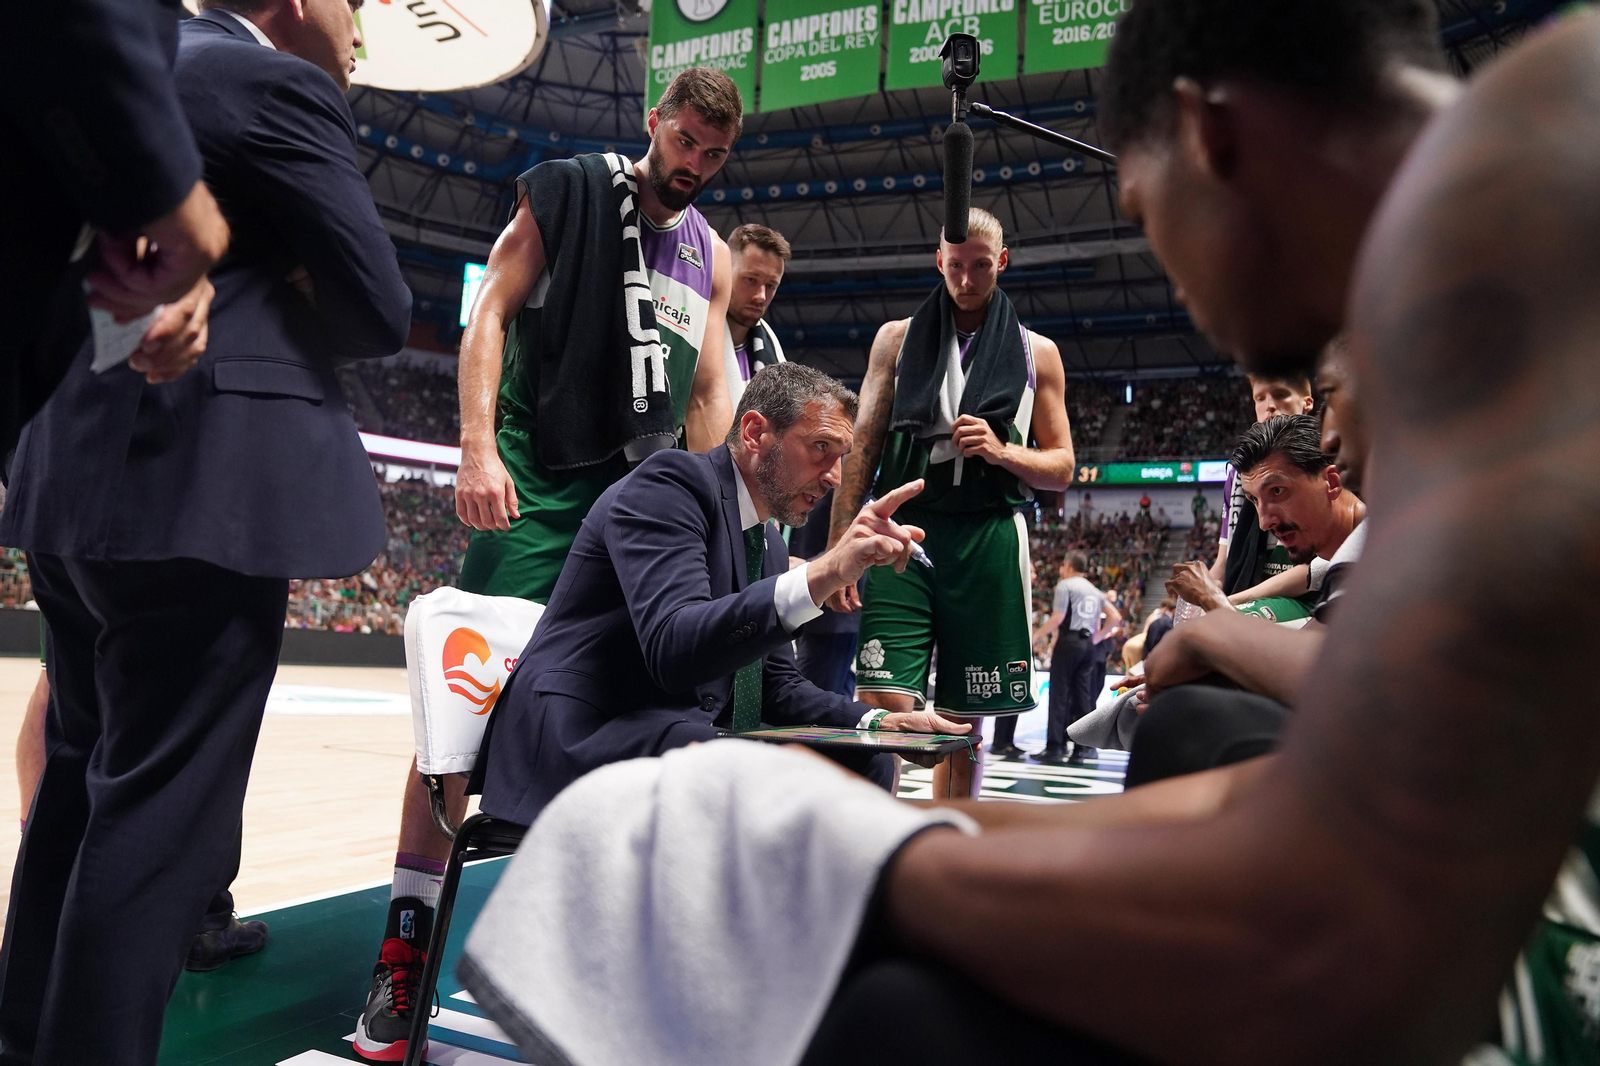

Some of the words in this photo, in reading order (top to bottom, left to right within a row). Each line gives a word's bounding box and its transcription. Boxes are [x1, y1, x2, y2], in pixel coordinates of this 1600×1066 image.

[768, 5, 878, 48] CAMPEONES
[651, 27, 753, 69] CAMPEONES
[764, 43, 806, 64] COPA
[809, 38, 841, 56] DEL
[844, 31, 879, 50] REY
[800, 61, 837, 81] 2005
[1078, 466, 1098, 482] 31
[1141, 467, 1173, 480] BARÇA
[971, 665, 1002, 683] má
[966, 679, 1002, 699] laga
